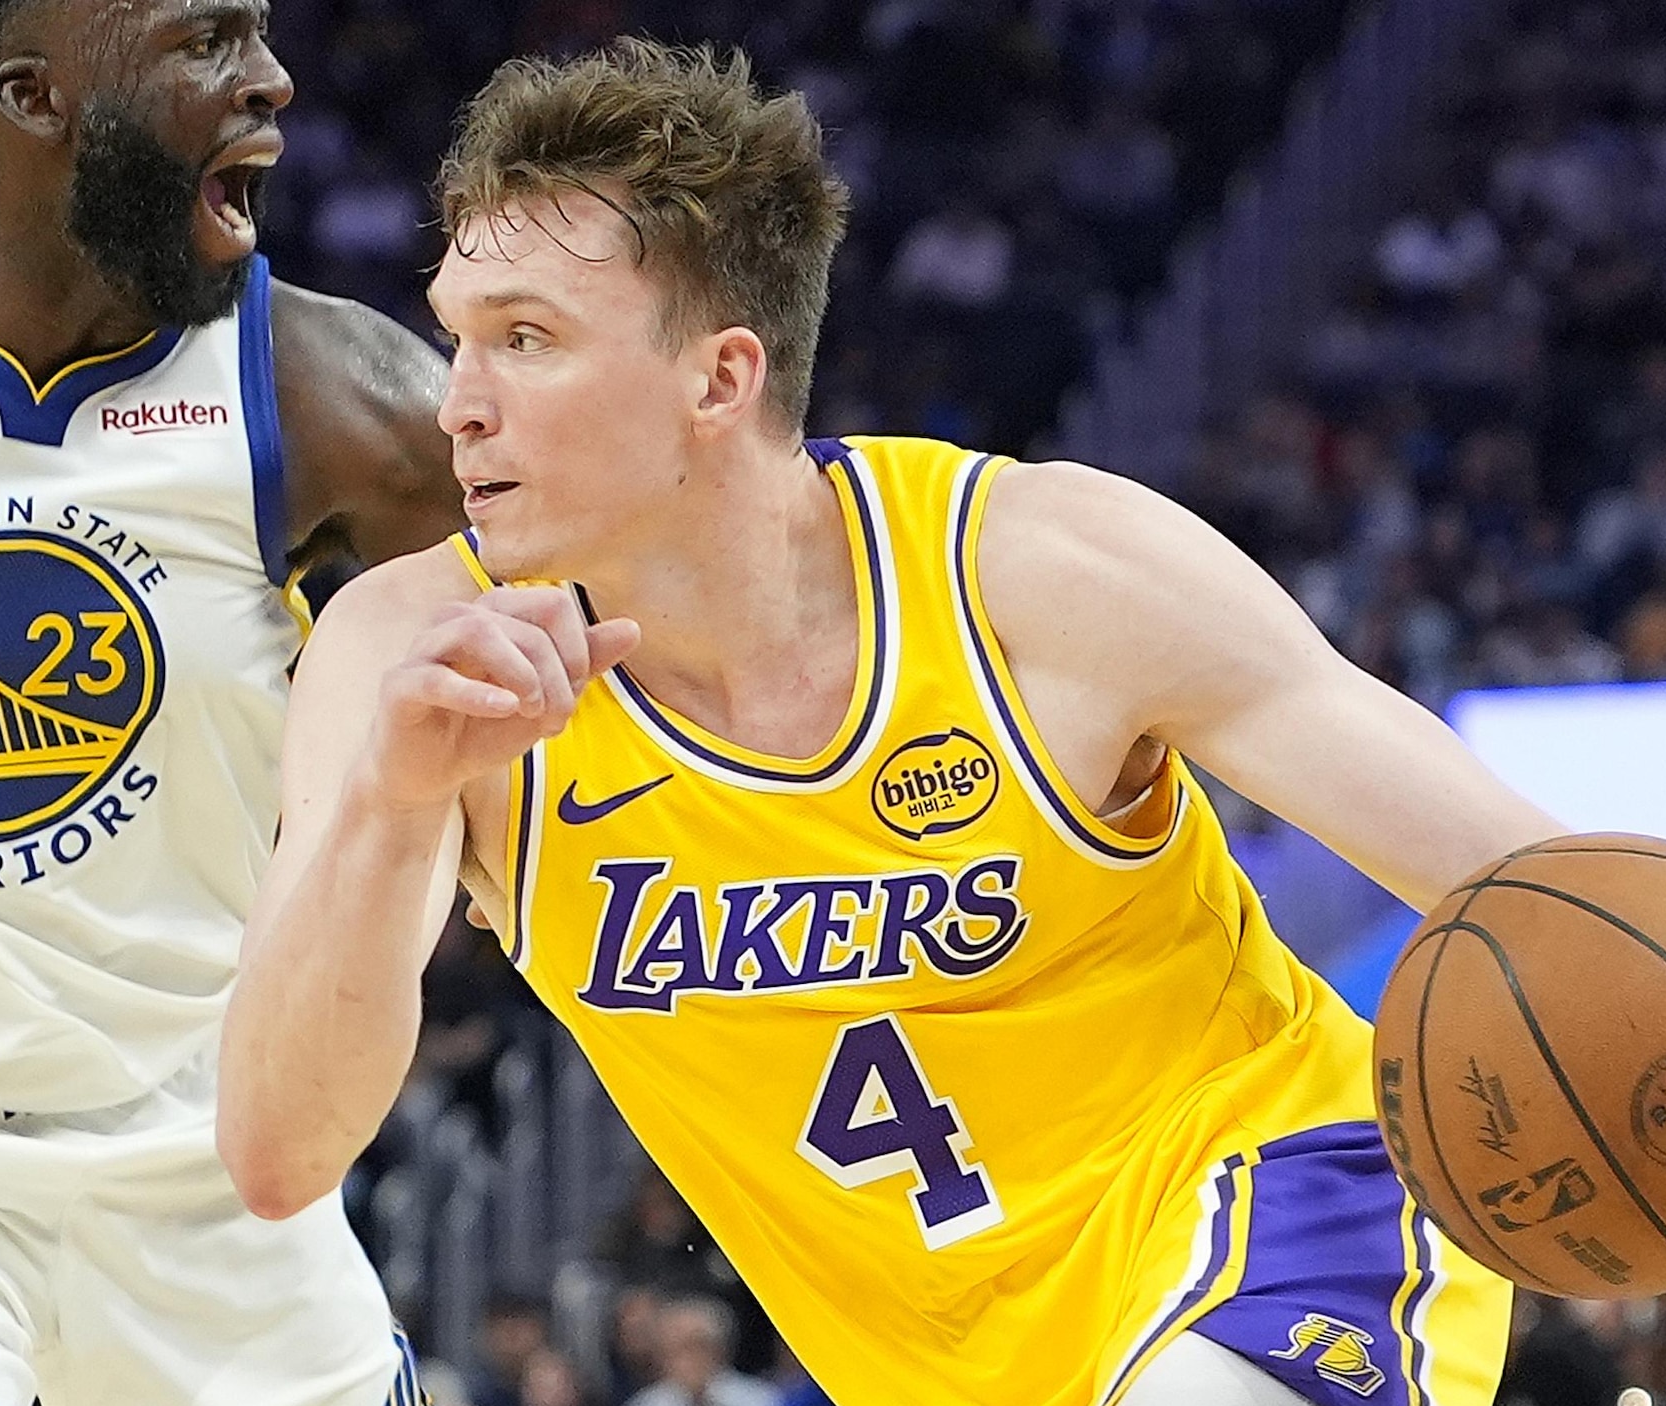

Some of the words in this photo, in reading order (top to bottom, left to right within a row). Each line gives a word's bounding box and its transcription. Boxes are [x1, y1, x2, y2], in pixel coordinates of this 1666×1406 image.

[101, 399, 228, 432] Rakuten
[57, 504, 168, 593] STATE
[21, 611, 127, 696] 23
[880, 756, 990, 808] bibigo
[907, 793, 956, 818] 비비고
[574, 854, 1033, 1016] LAKERS
[794, 1010, 1006, 1252] 4
